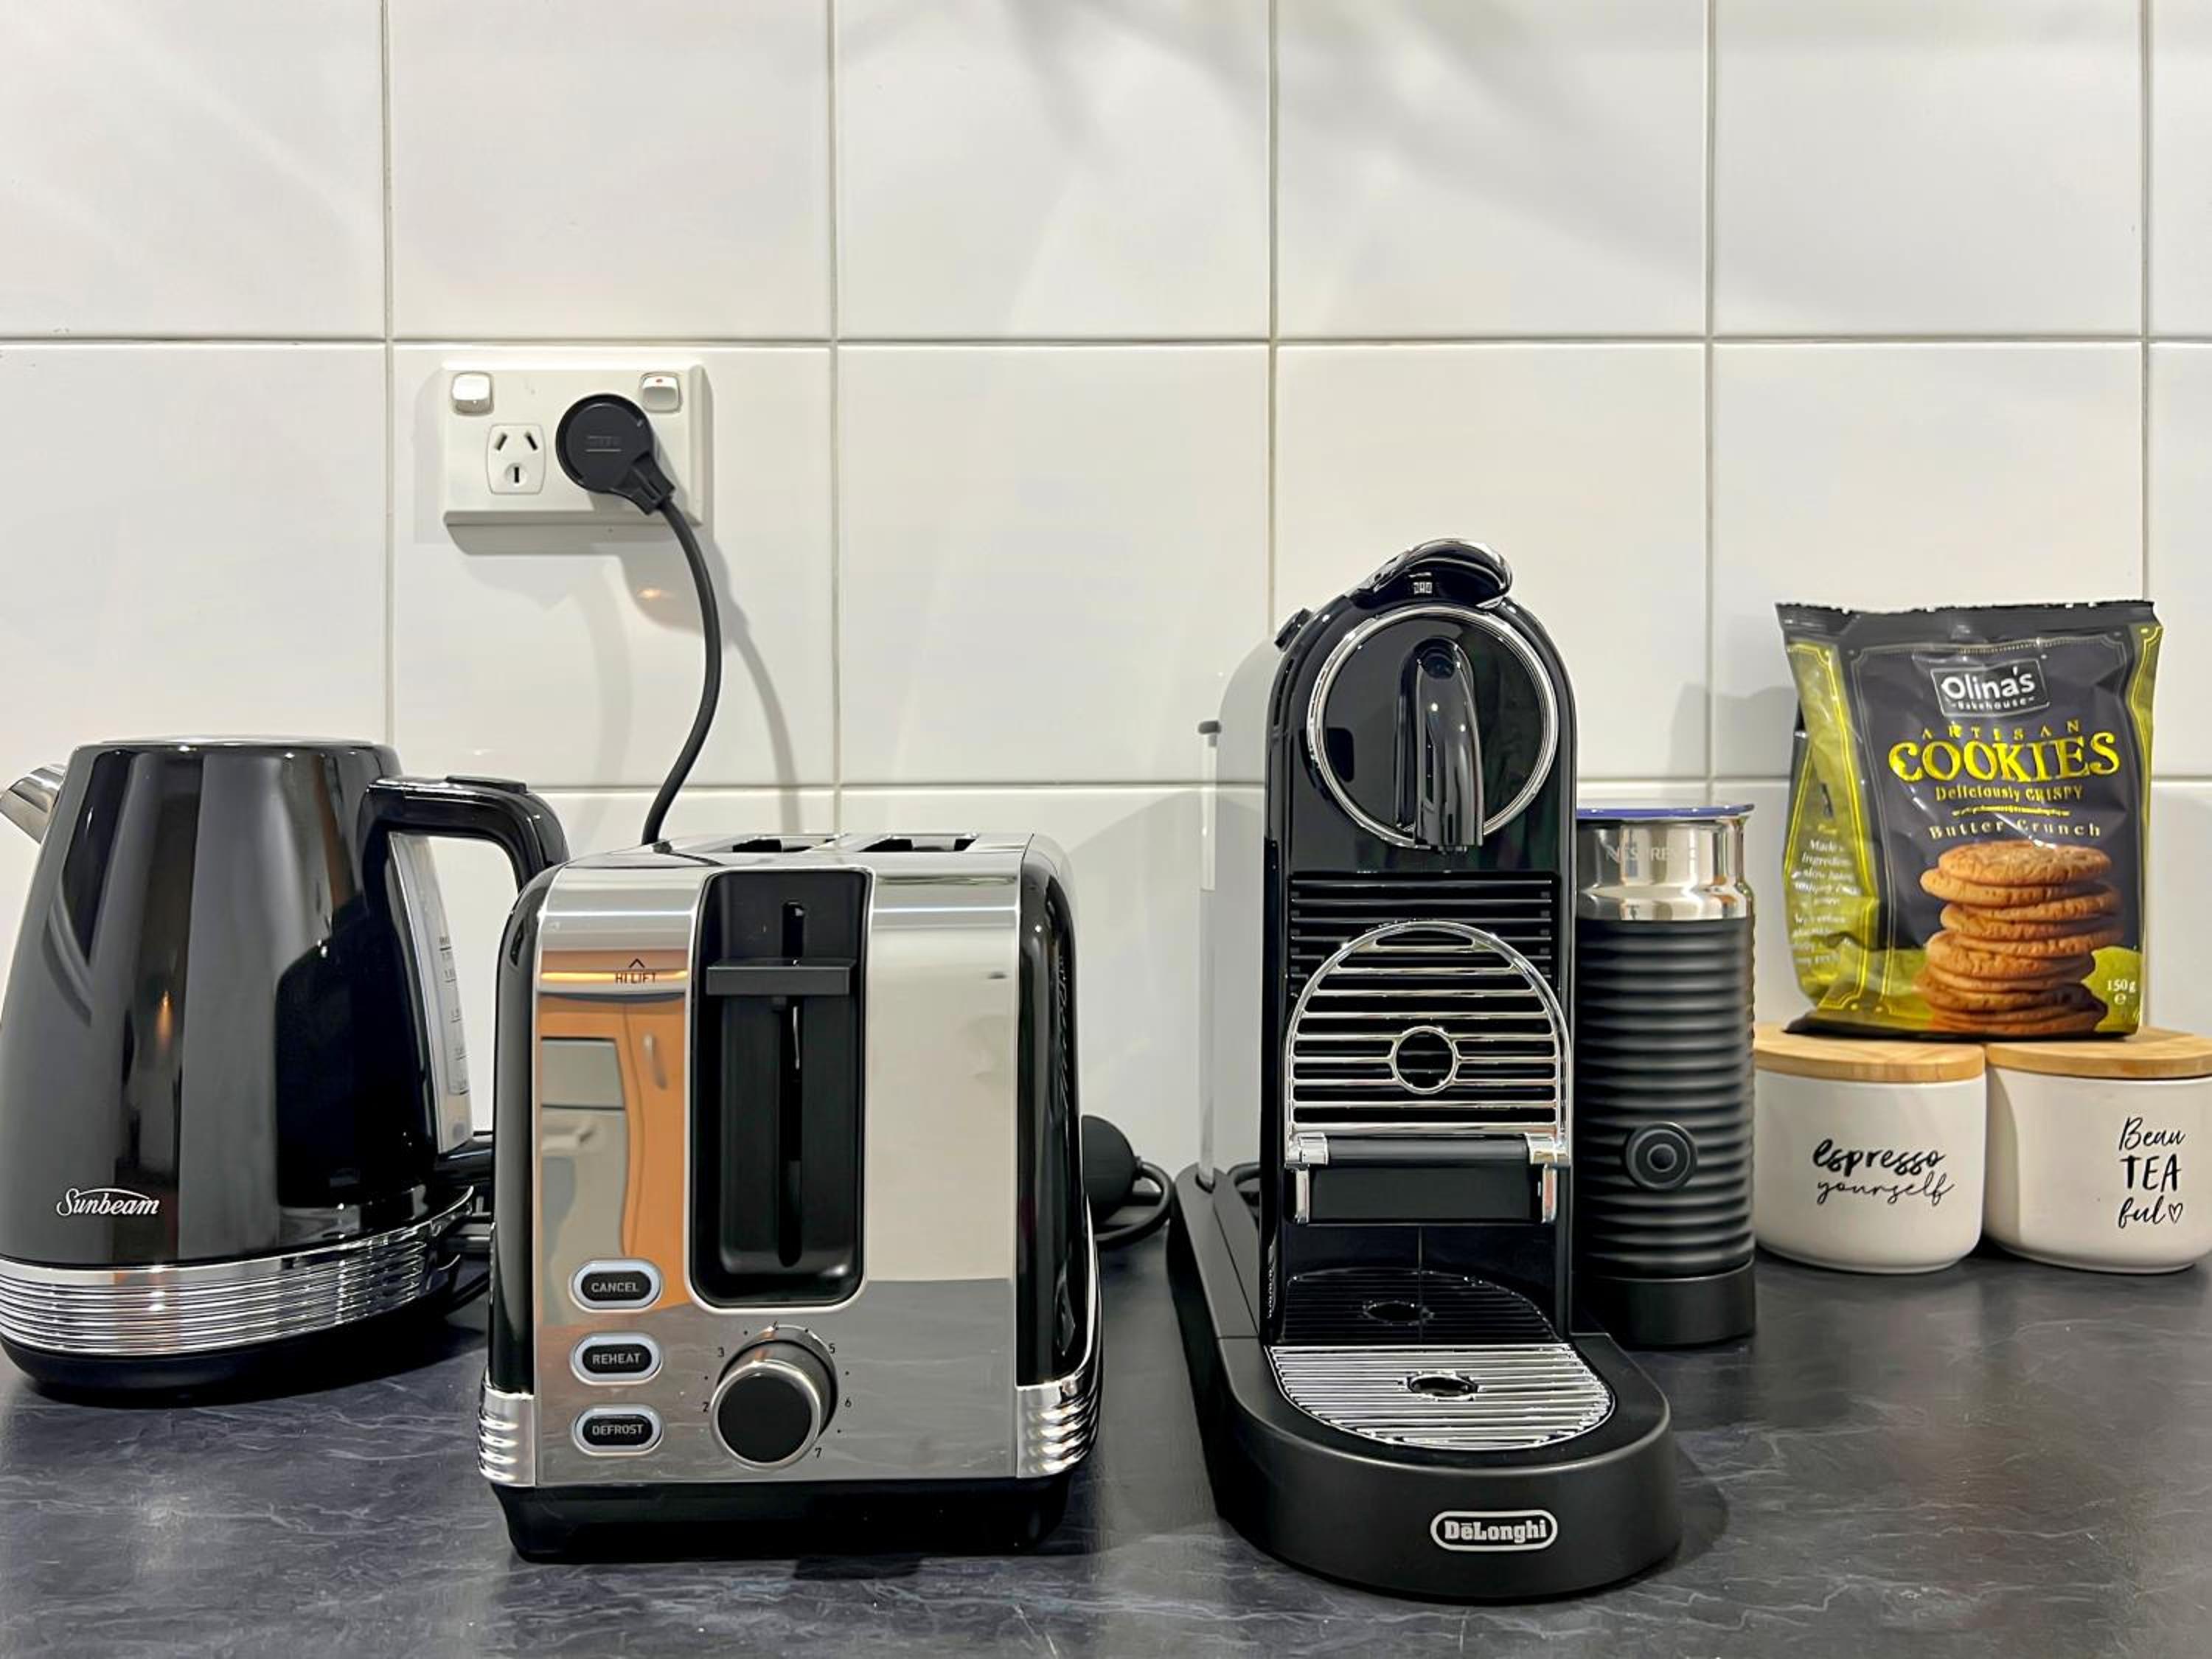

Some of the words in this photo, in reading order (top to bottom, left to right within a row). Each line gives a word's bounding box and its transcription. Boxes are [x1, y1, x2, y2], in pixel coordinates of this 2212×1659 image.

[1941, 666, 2036, 700] Olina's
[1921, 719, 2081, 741] ARTISAN
[1888, 731, 2121, 782] COOKIES
[1935, 785, 2020, 802] Deliciously
[2025, 785, 2084, 801] CRISPY
[1928, 818, 2005, 839] Butter
[2016, 818, 2101, 838] Crunch
[615, 971, 627, 984] HI
[630, 971, 656, 984] LIFT
[2118, 1116, 2186, 1151] Beau
[1812, 1138, 1947, 1178] espresso
[2119, 1153, 2183, 1193] TEA
[1816, 1170, 1955, 1207] yourself
[56, 1188, 160, 1216] Sunbeam
[591, 1281, 641, 1293] CANCEL
[717, 1346, 725, 1357] 3
[828, 1343, 836, 1354] 5
[591, 1353, 641, 1366] REHEAT
[702, 1402, 709, 1413] 2
[844, 1397, 852, 1408] 6
[591, 1423, 644, 1436] DEFROST
[814, 1447, 823, 1458] 7
